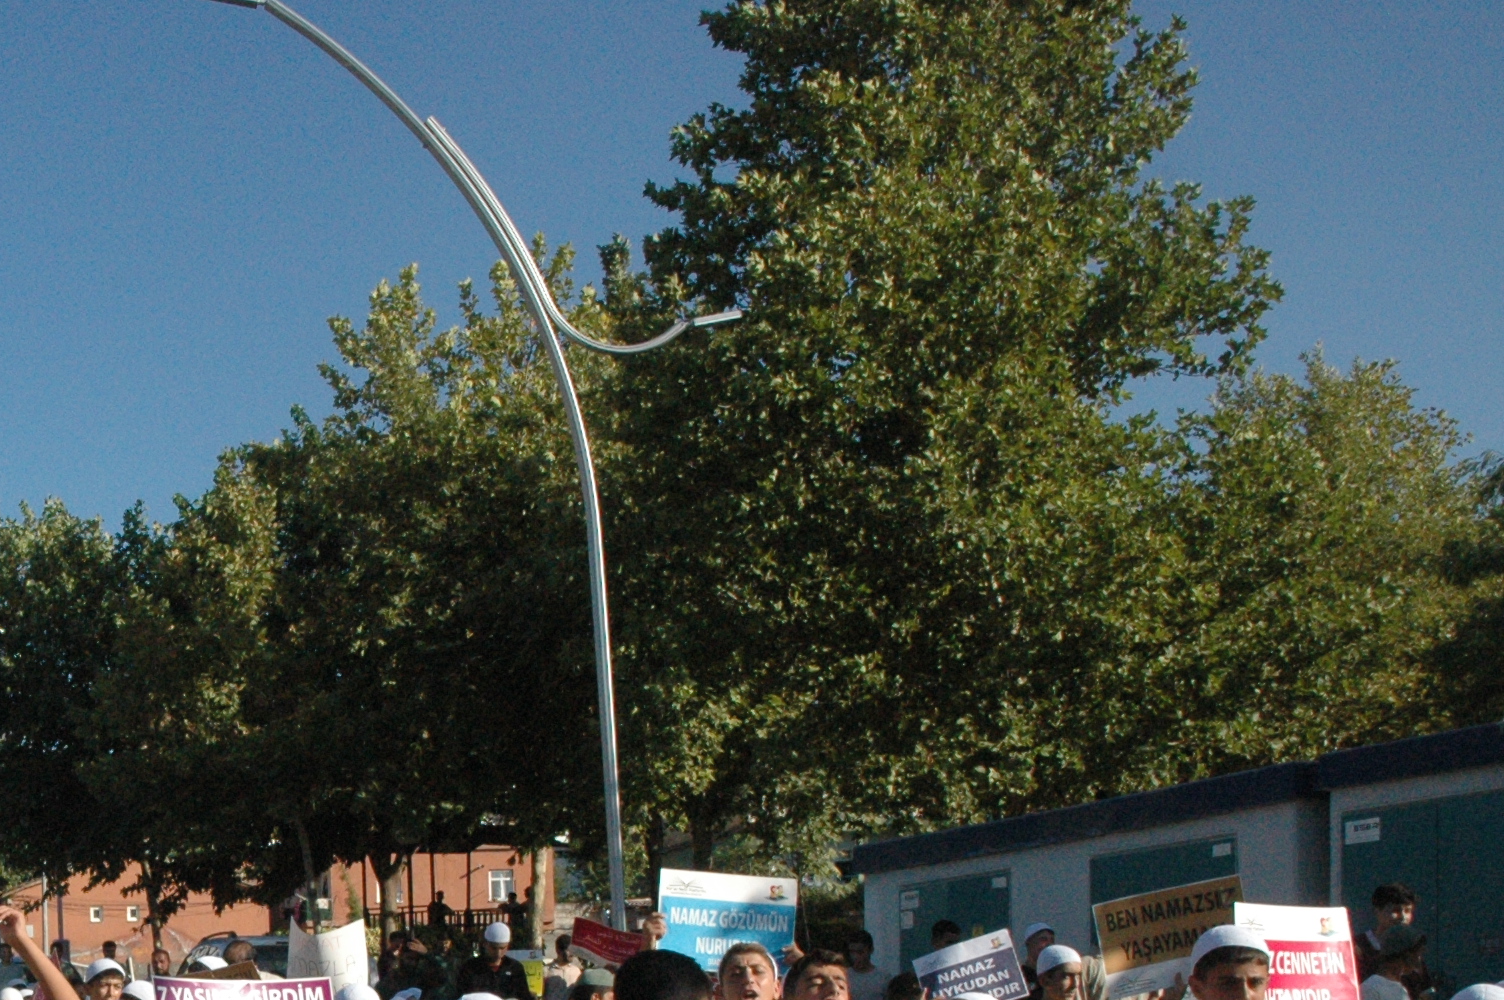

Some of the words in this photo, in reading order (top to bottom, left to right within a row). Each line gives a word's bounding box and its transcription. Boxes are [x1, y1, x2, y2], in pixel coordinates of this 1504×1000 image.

[670, 906, 717, 928] NAMAZ
[719, 908, 789, 933] GÖZÜMÜN
[1105, 908, 1137, 933] BEN
[937, 957, 996, 984] NAMAZ
[1276, 947, 1345, 976] CENNETİN
